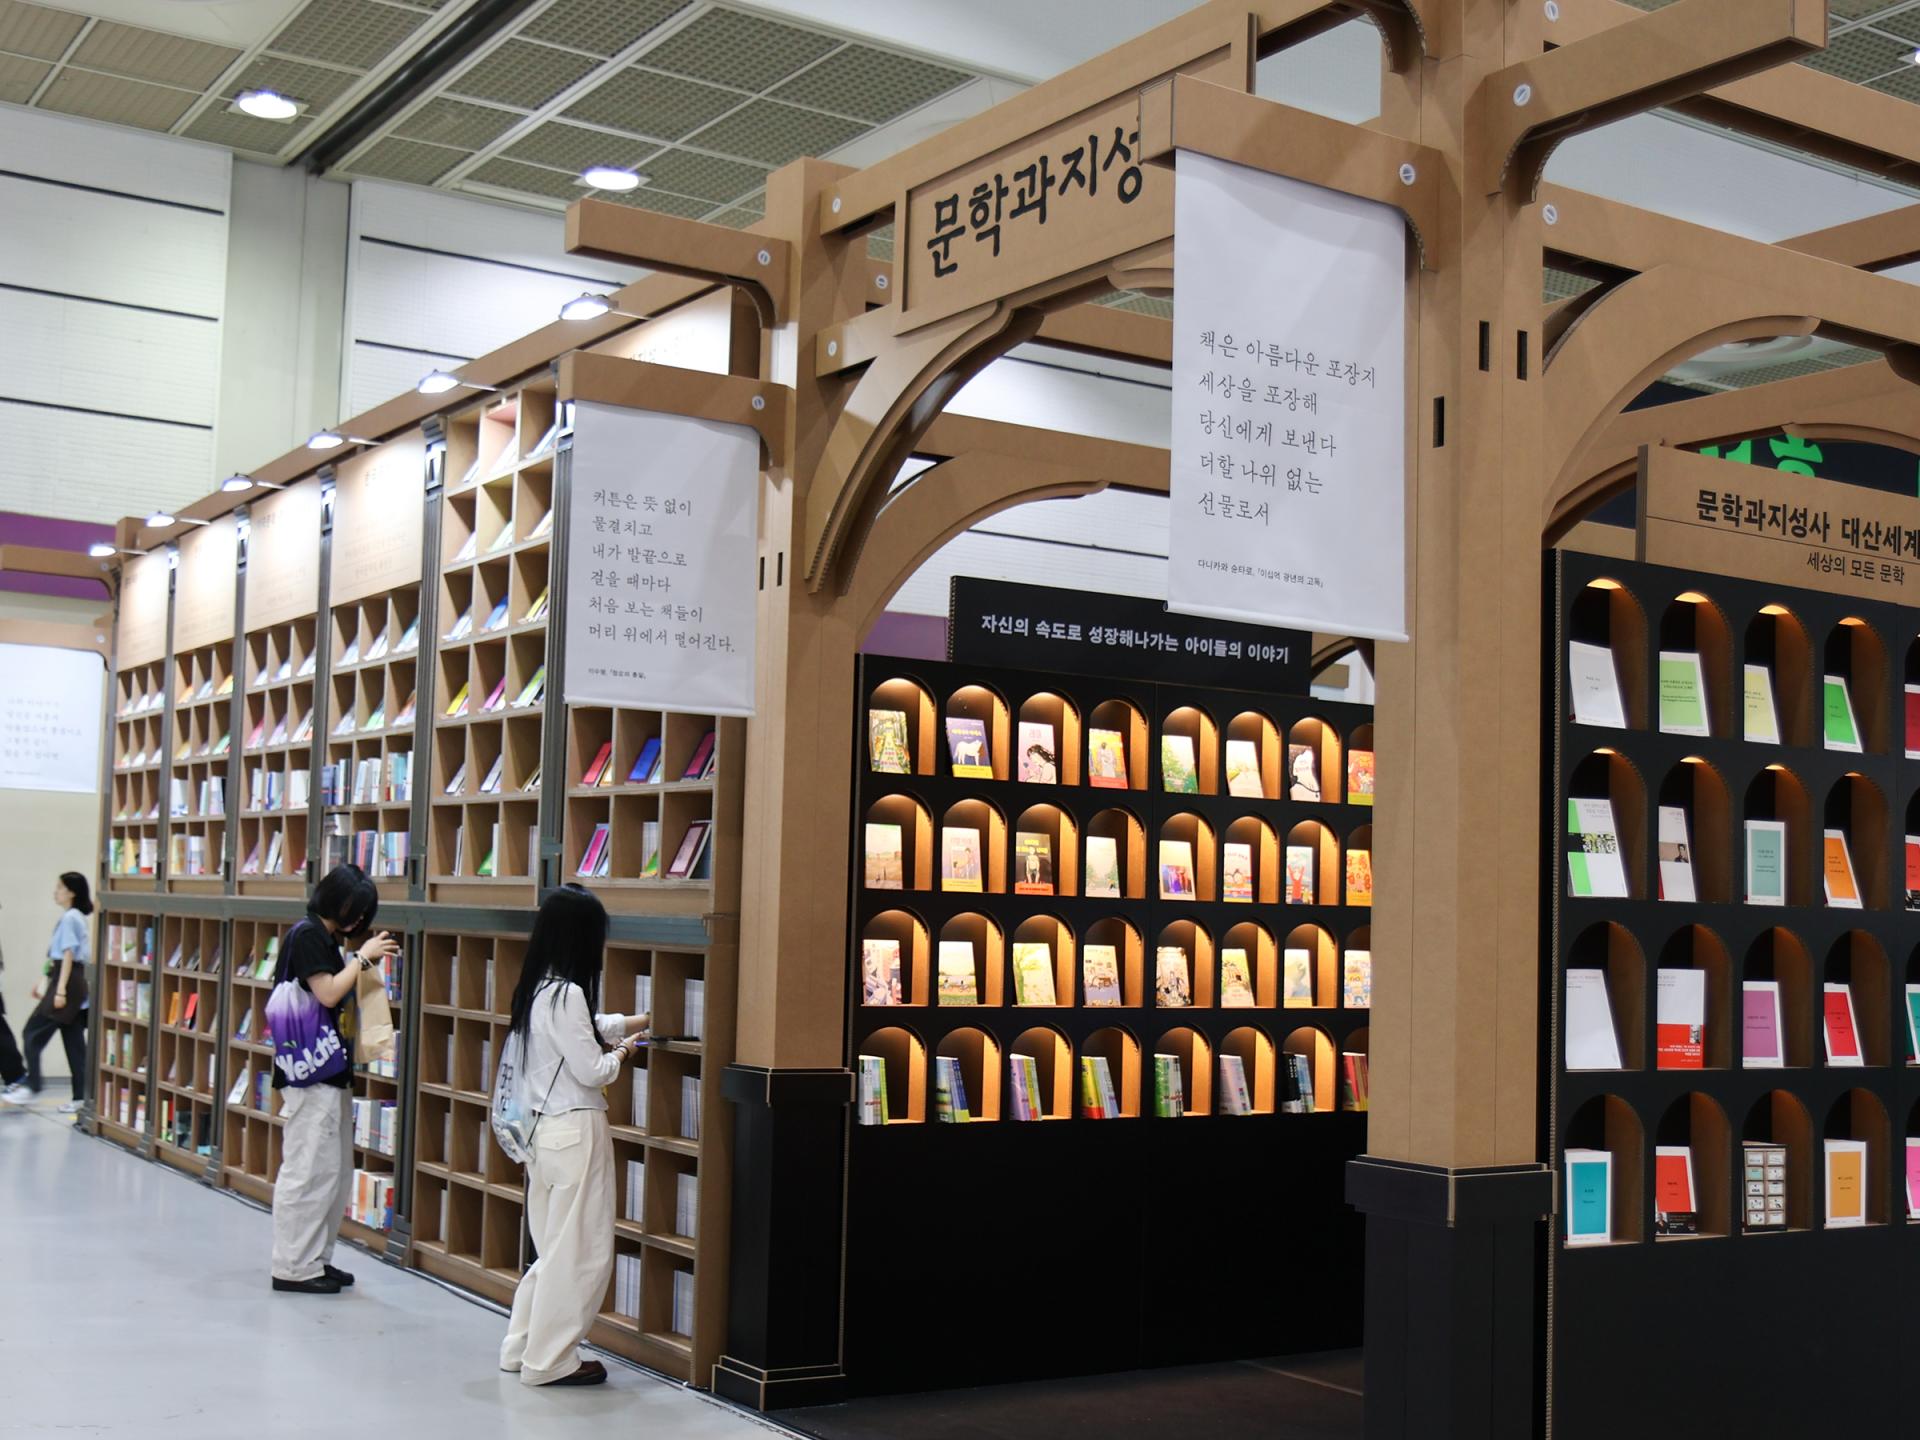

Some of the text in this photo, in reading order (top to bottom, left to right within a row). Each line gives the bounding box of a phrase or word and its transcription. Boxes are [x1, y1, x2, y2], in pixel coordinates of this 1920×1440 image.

[927, 117, 1142, 278] 문학과지성
[1200, 331, 1375, 388] 책은 아름다운 포장지
[1199, 372, 1317, 415] 세상을 포장해
[1200, 410, 1336, 457] 당신에게 보낸다
[1200, 452, 1323, 494] 더할 나위 없는
[592, 489, 691, 517] 커튼은 뜻 없이
[1198, 491, 1269, 526] 선물로서
[592, 515, 653, 536] 물결치고
[1696, 489, 1920, 561] 문학과지성사 대산세계
[592, 543, 687, 566] 내가 발끝으로
[1807, 552, 1905, 586] 세상의 모든 문학
[590, 569, 671, 592] 걸을 때마다
[589, 596, 703, 623] 처음 보는 책들이
[589, 623, 736, 653] 머리 위에서 떨어진다.
[981, 614, 1289, 664] 자신의 속도로 성장해나가는 아이들의 이야기
[275, 1025, 341, 1082] Welch's
